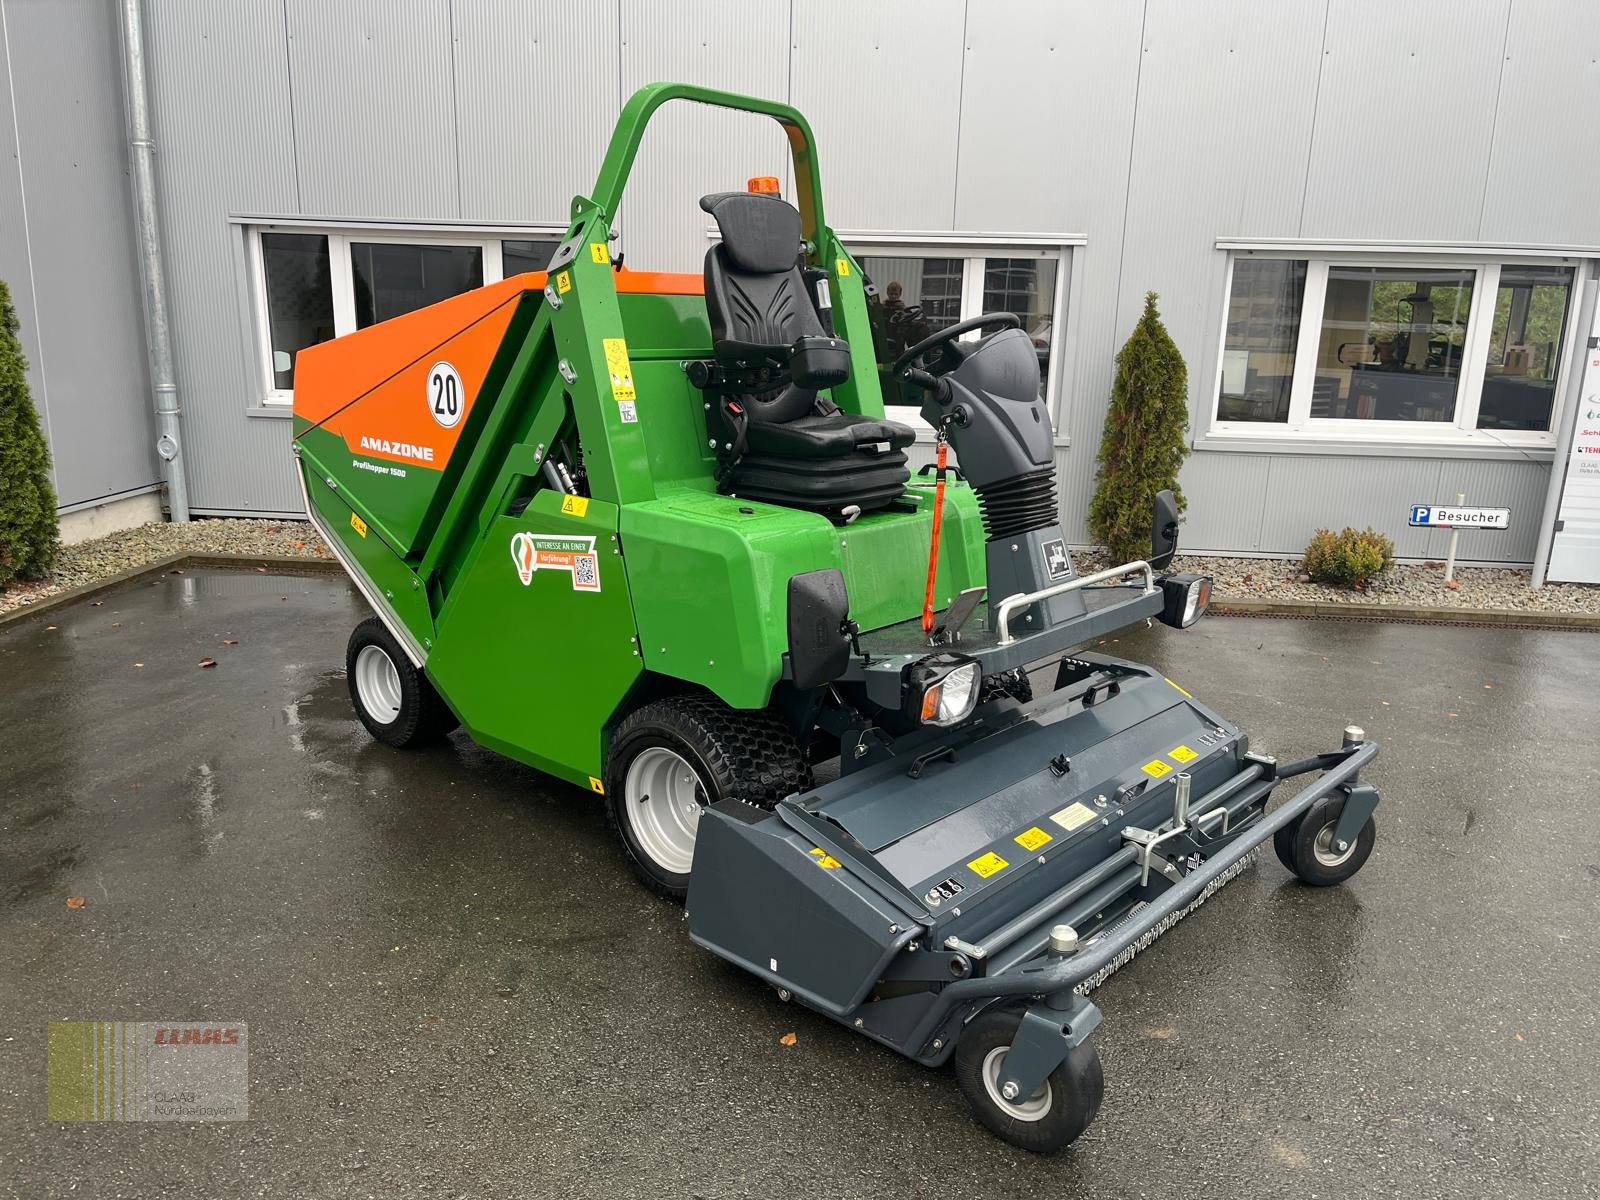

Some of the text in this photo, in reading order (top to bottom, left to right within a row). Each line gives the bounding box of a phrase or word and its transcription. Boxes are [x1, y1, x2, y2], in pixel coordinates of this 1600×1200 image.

[433, 373, 458, 416] 20
[360, 436, 434, 462] AMAZONE
[352, 460, 406, 478] Profihopper 1500
[1438, 510, 1501, 523] Besucher
[536, 541, 586, 551] INTERESSE AN EINER
